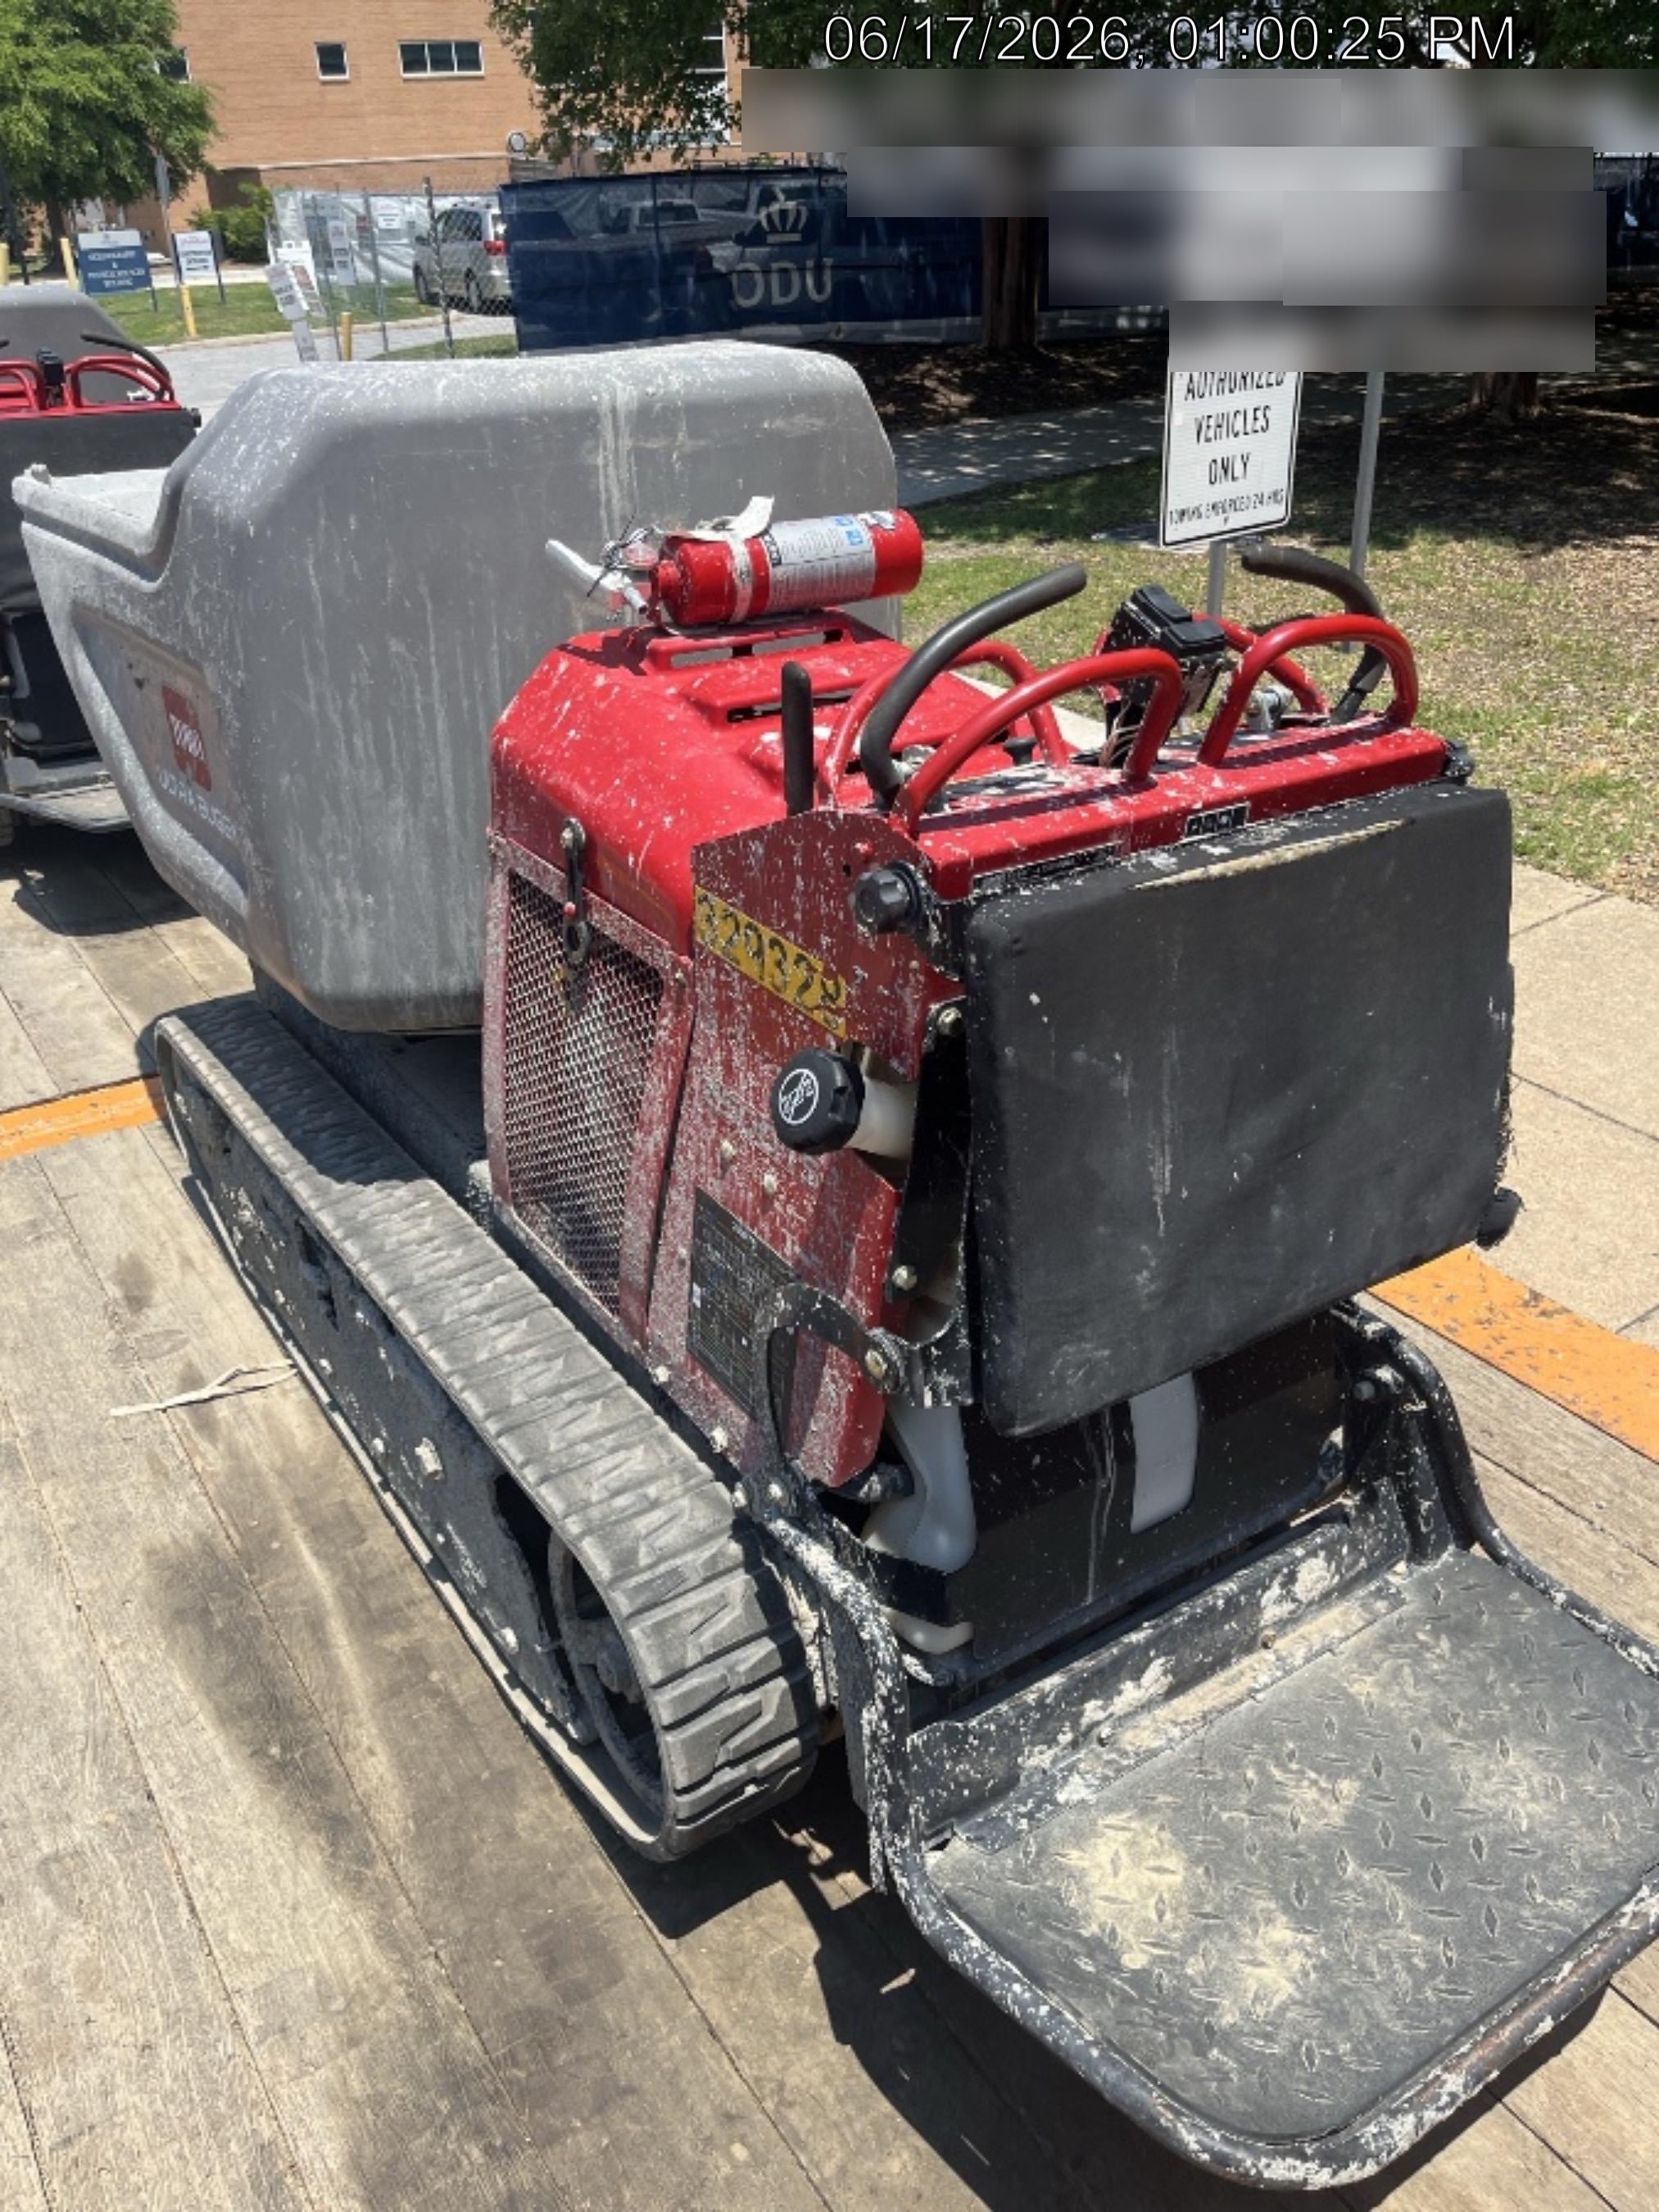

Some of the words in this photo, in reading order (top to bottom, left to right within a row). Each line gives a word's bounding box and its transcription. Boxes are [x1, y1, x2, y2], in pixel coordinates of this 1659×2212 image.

[732, 257, 834, 308] ODU
[1194, 405, 1271, 445] VEHICLES
[1208, 452, 1251, 485] ONLY
